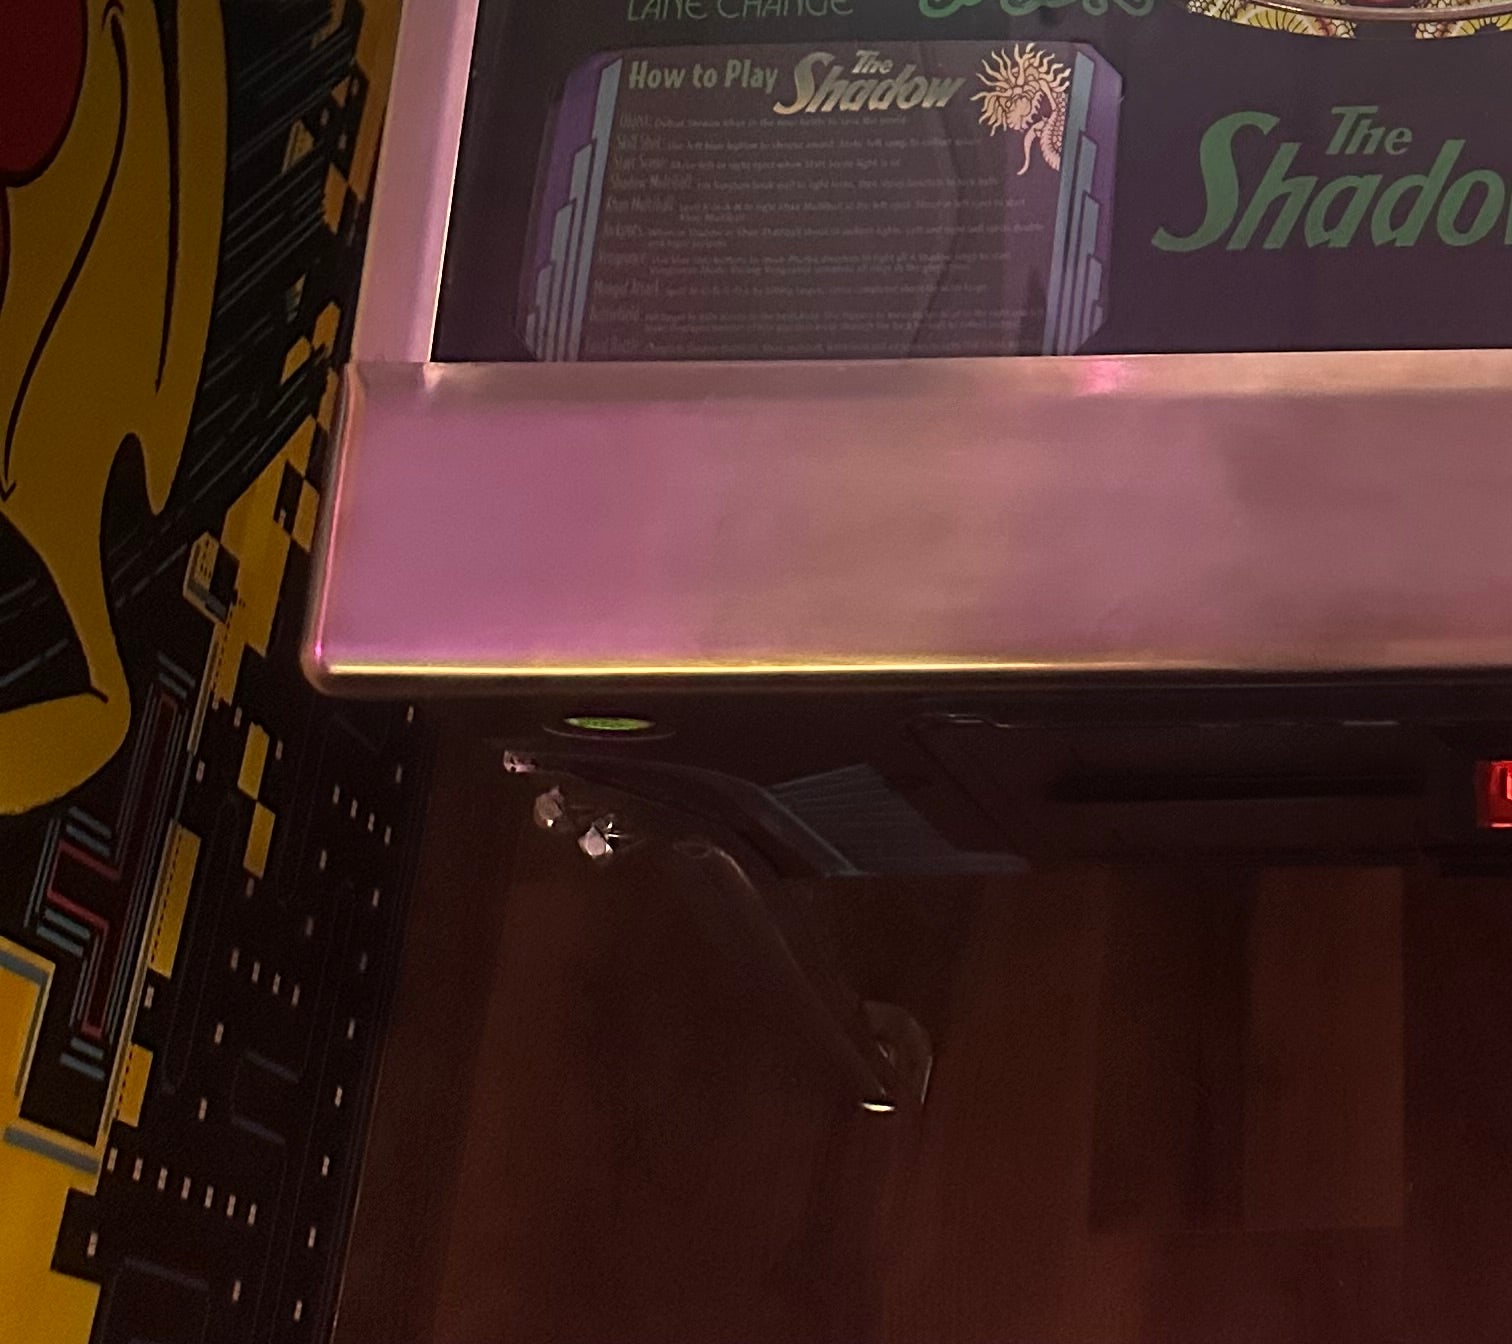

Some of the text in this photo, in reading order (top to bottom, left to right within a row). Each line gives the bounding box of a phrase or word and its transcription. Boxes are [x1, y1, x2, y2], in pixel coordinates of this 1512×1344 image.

[628, 59, 779, 94] How to Play
[773, 51, 966, 115] Shadow
[852, 49, 893, 75] The
[1325, 105, 1414, 156] The
